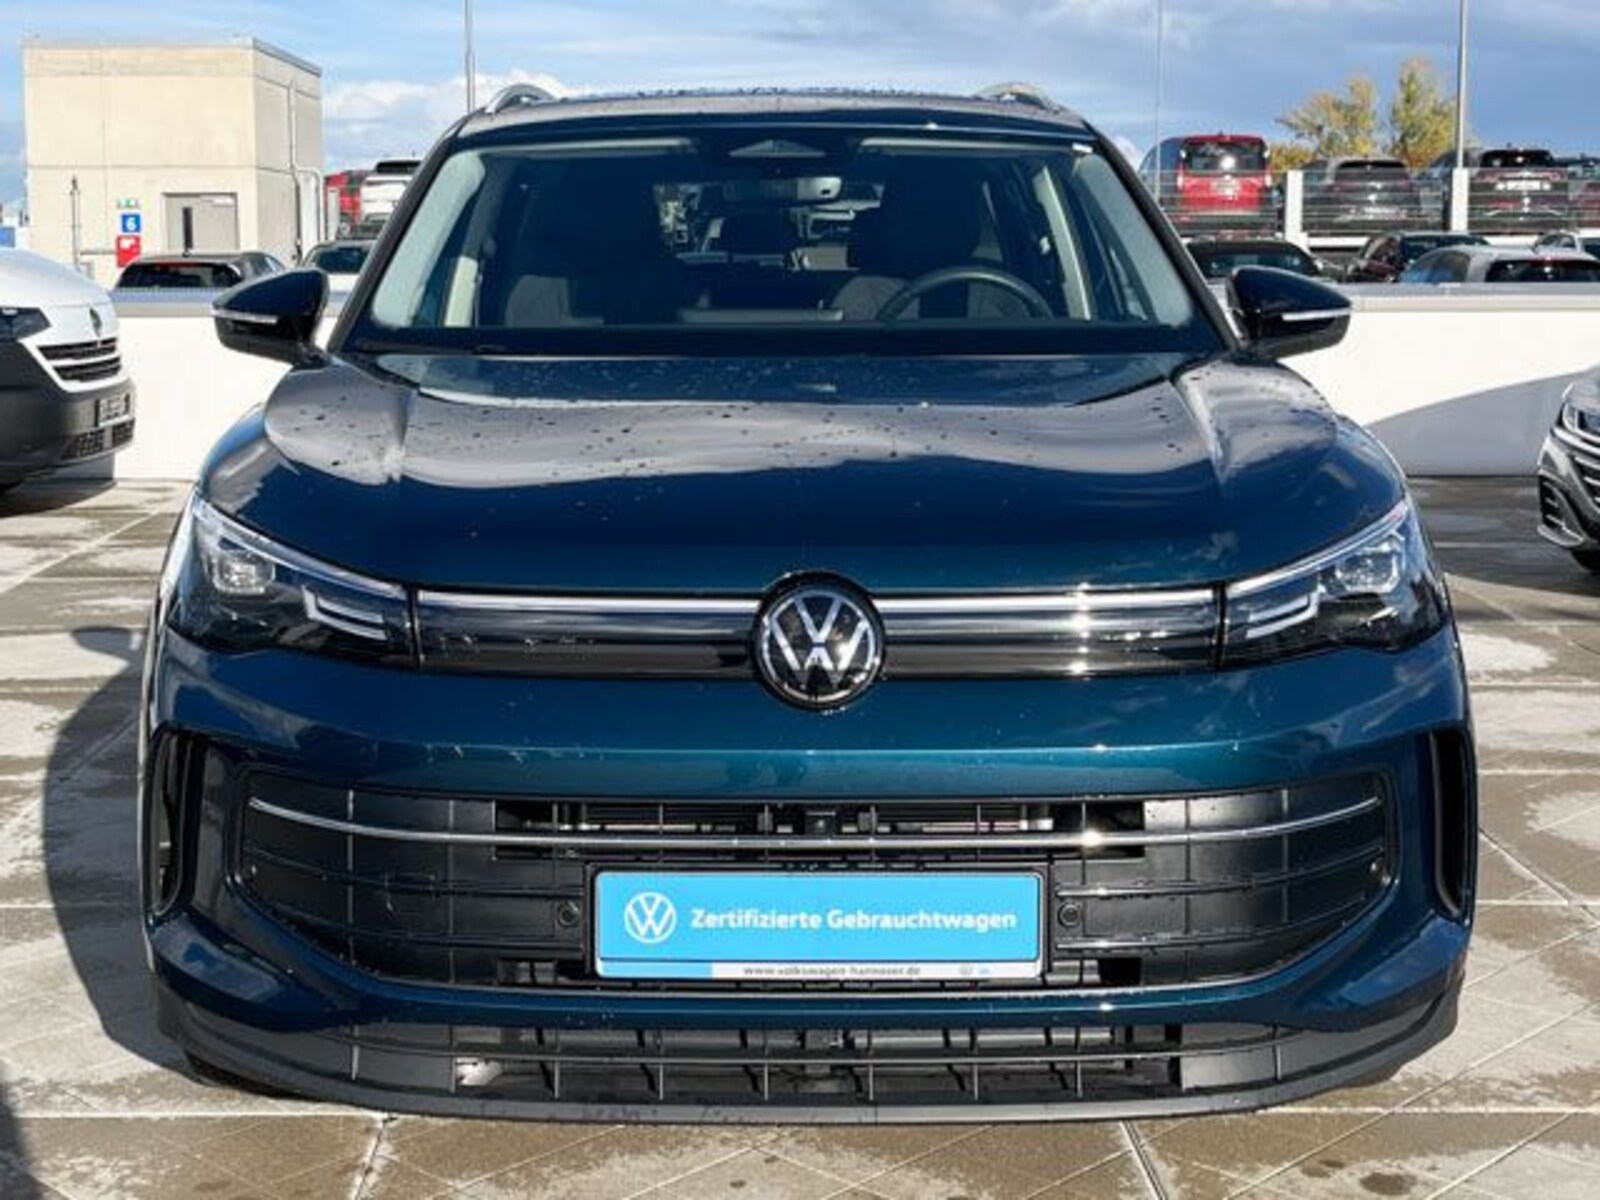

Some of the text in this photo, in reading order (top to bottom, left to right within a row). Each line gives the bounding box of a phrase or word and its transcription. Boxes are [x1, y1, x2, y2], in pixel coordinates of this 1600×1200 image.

[127, 217, 136, 231] 6
[691, 908, 1017, 932] Zertifizierte Gebrauchtwagen
